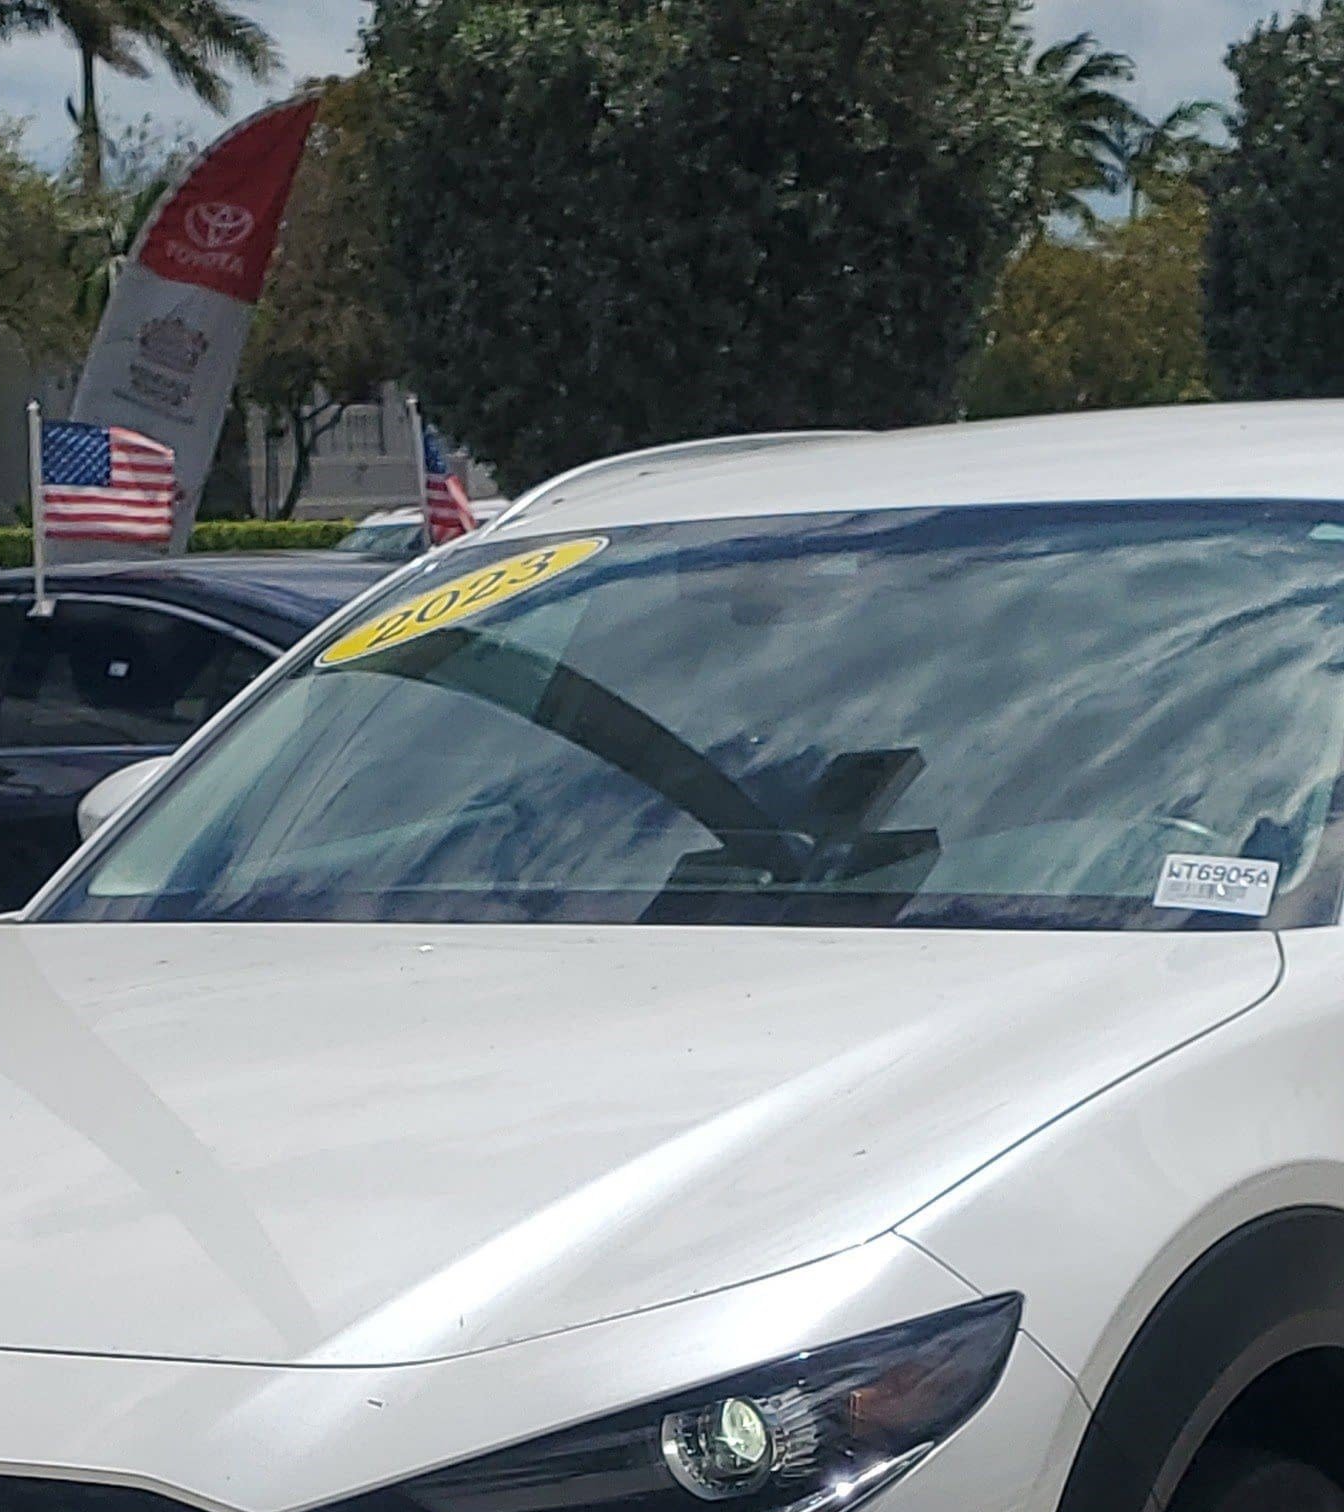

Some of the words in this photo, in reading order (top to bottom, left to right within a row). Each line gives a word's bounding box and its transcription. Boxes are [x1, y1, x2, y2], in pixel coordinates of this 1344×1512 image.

[164, 240, 245, 275] TOYOTA
[366, 550, 556, 648] 2023
[1166, 861, 1270, 886] WT6905A
